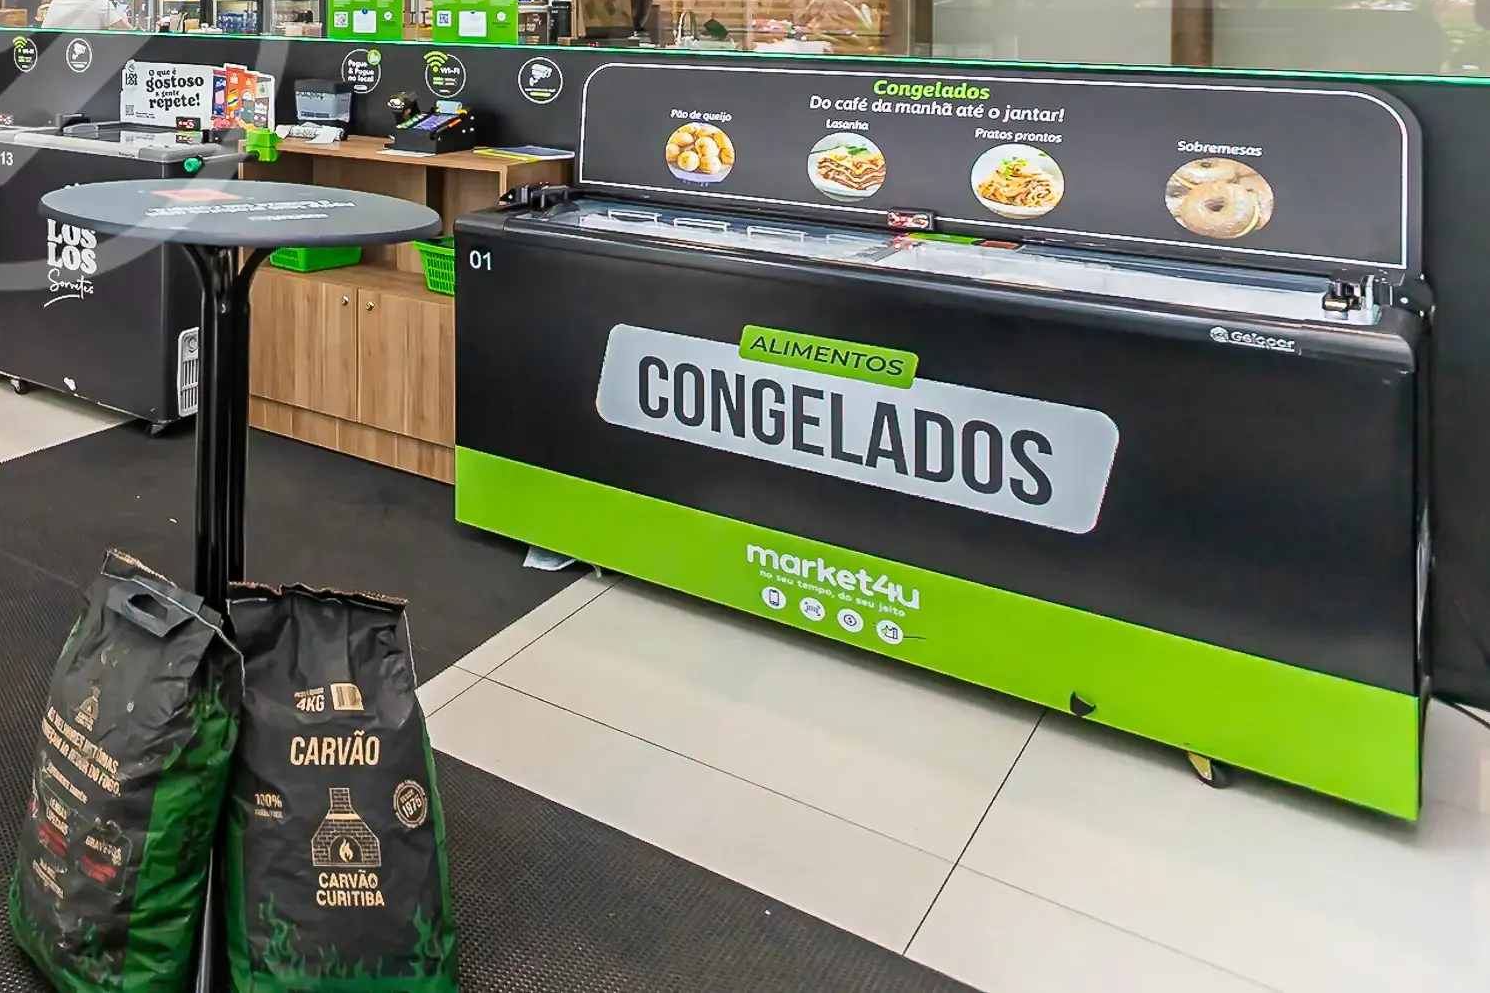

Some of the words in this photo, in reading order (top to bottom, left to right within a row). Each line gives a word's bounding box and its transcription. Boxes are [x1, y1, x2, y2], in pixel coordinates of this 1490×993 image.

[148, 69, 155, 77] O
[156, 70, 171, 78] que
[172, 67, 177, 76] é
[146, 76, 204, 93] gostoso
[873, 79, 991, 101] Congelados
[149, 93, 201, 111] repete!
[161, 90, 180, 98] gente
[670, 108, 689, 121] Pão
[690, 109, 702, 121] de
[702, 111, 733, 124] queijo
[810, 95, 832, 111] Do
[834, 97, 867, 112] café
[871, 98, 893, 114] da
[894, 100, 953, 117] manhã
[955, 103, 985, 119] até
[987, 107, 1001, 120] o
[1001, 105, 1066, 123] jantar!
[826, 118, 870, 132] Lasanha
[975, 127, 1013, 142] Pratos
[1013, 130, 1063, 144] prontos
[1176, 140, 1263, 157] Sobremesas
[0, 151, 14, 166] 13
[47, 241, 97, 274] LOS
[469, 249, 493, 271] 01
[749, 335, 905, 377] ALIMENTOS
[637, 354, 1053, 506] CONGELADOS
[746, 543, 920, 610] market4u
[760, 569, 773, 579] no
[776, 574, 794, 586] seu
[797, 579, 835, 599] tempo,
[838, 591, 852, 602] do
[855, 598, 875, 609] seu
[878, 601, 906, 618] jeito
[296, 694, 326, 712] 4KG
[290, 730, 381, 766] CARVÃO
[254, 793, 283, 808] 100%
[318, 869, 379, 889] CARVÃO
[316, 890, 386, 907] CURITIBA
